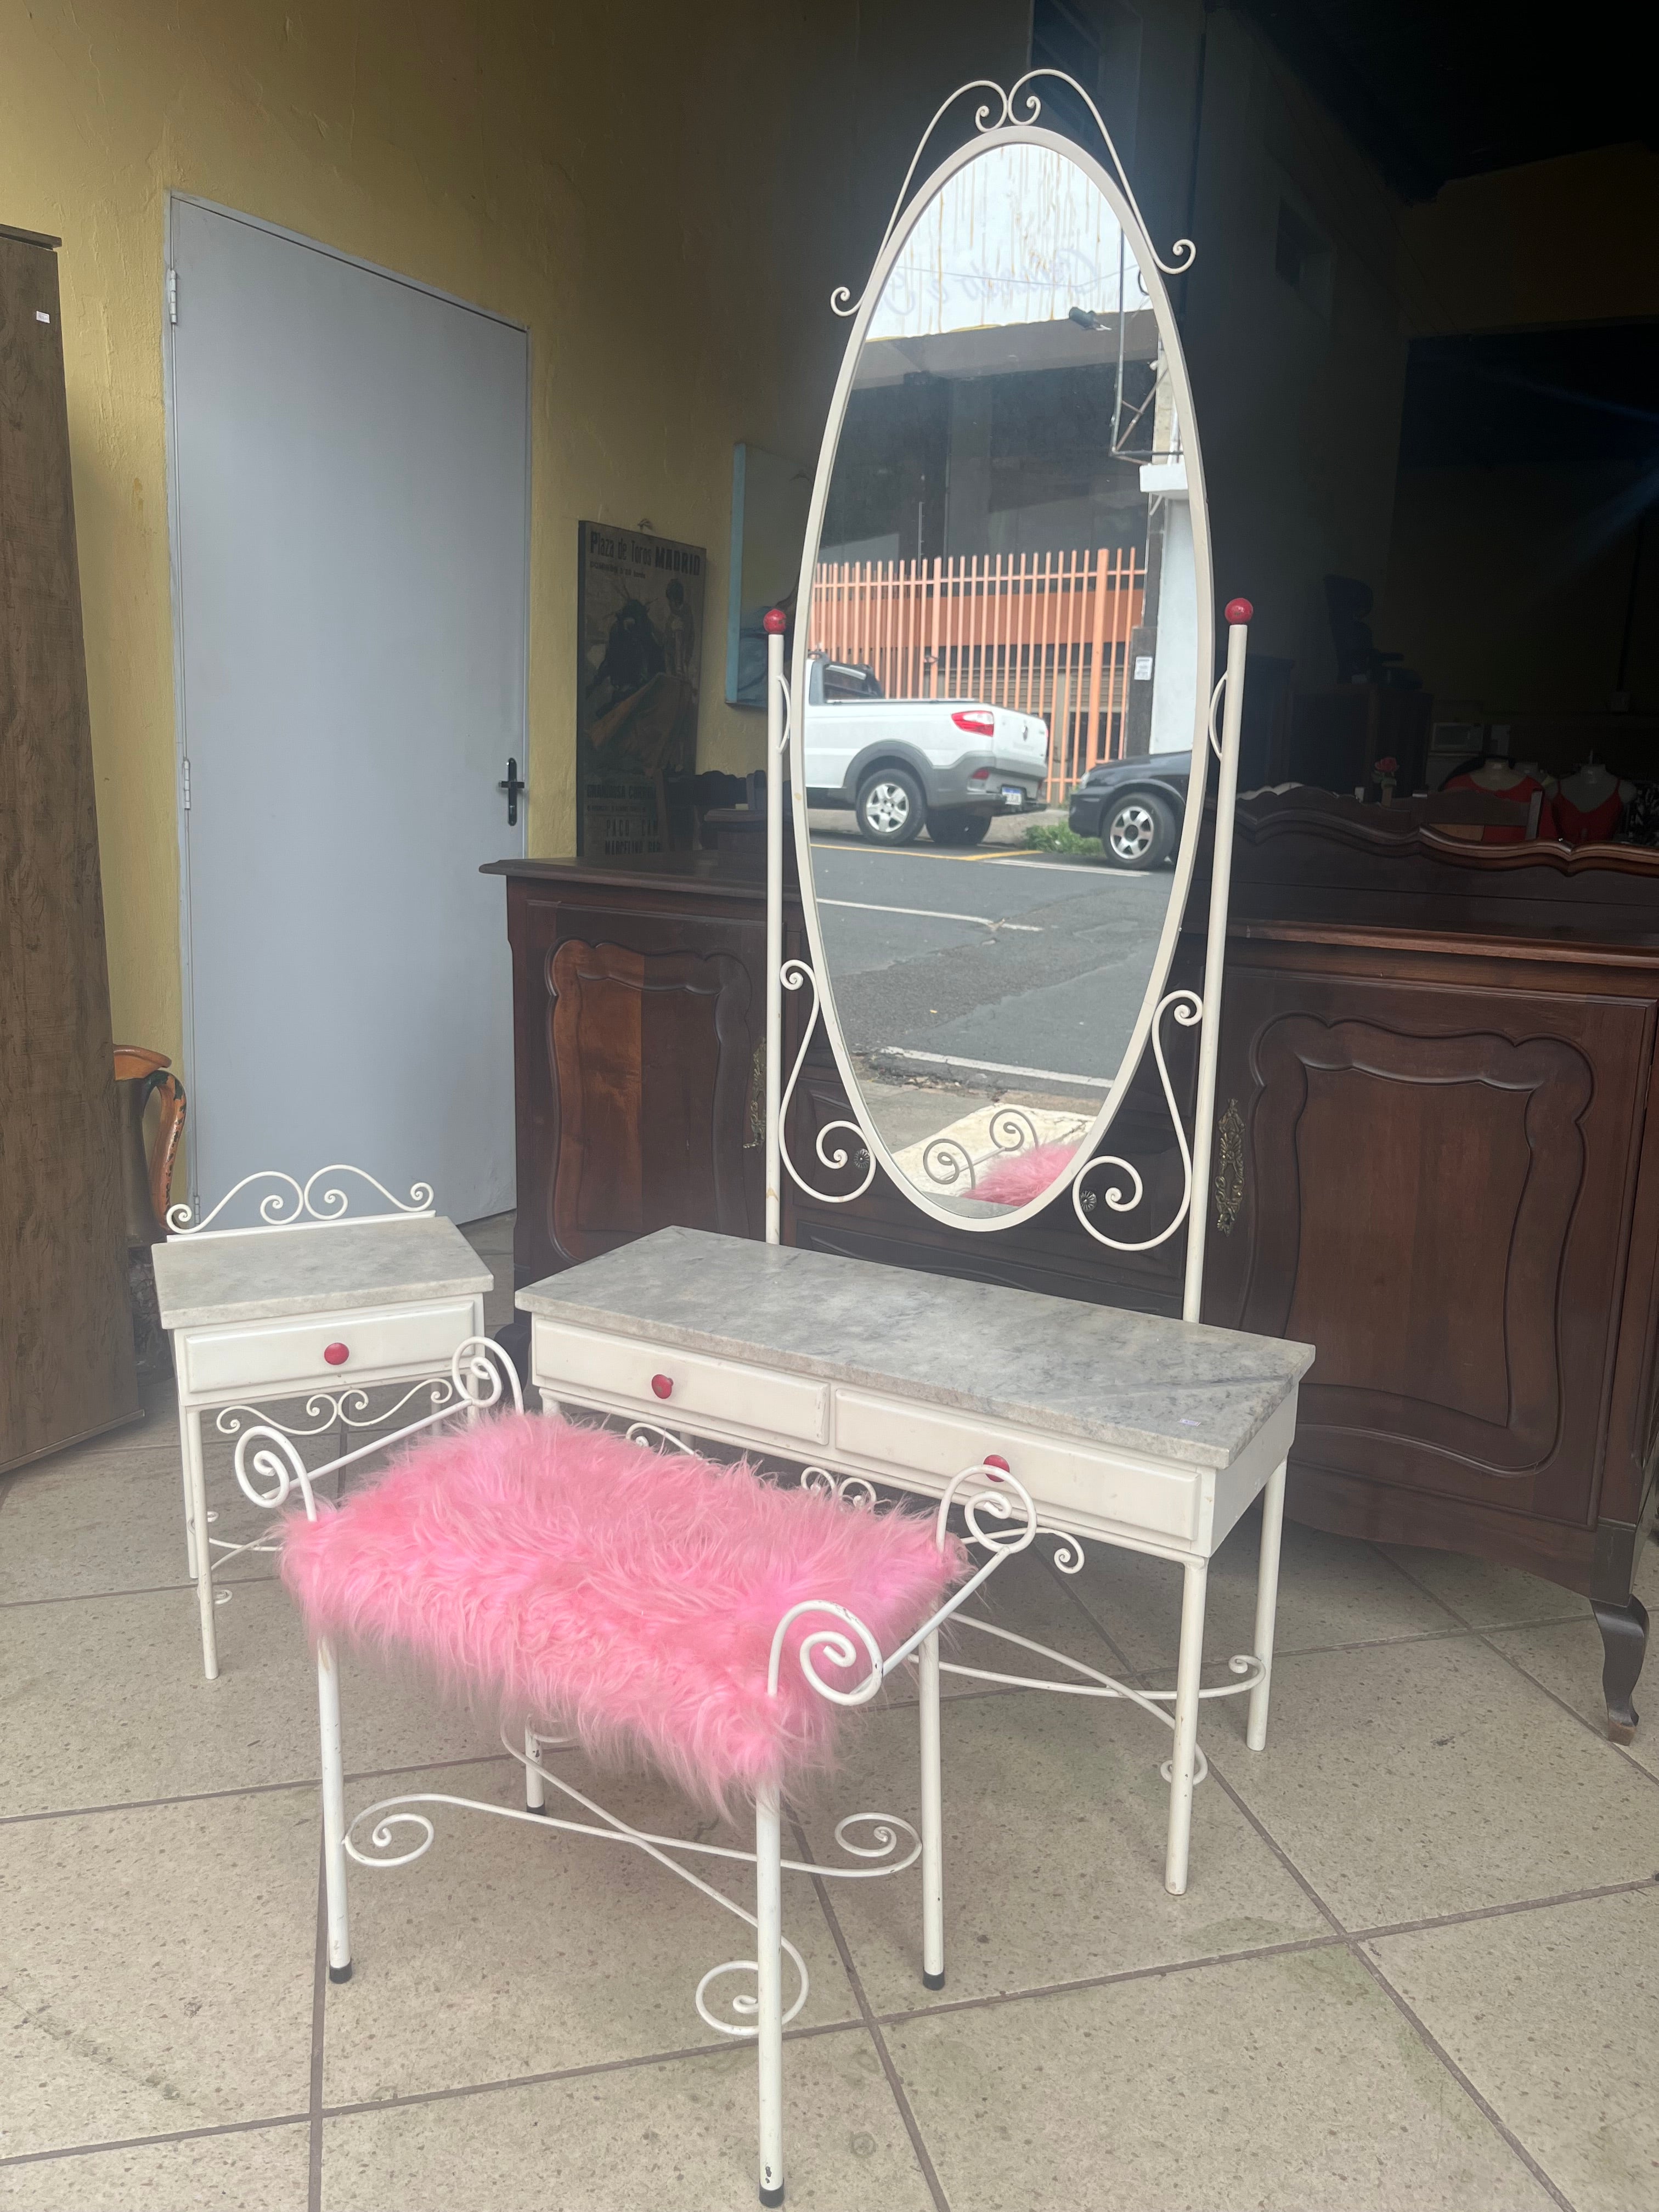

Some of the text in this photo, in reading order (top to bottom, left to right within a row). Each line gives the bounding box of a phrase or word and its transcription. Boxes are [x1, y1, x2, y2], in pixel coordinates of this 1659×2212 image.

[590, 531, 700, 575] Plaza de Toros MADRID
[606, 819, 629, 837] PACO
